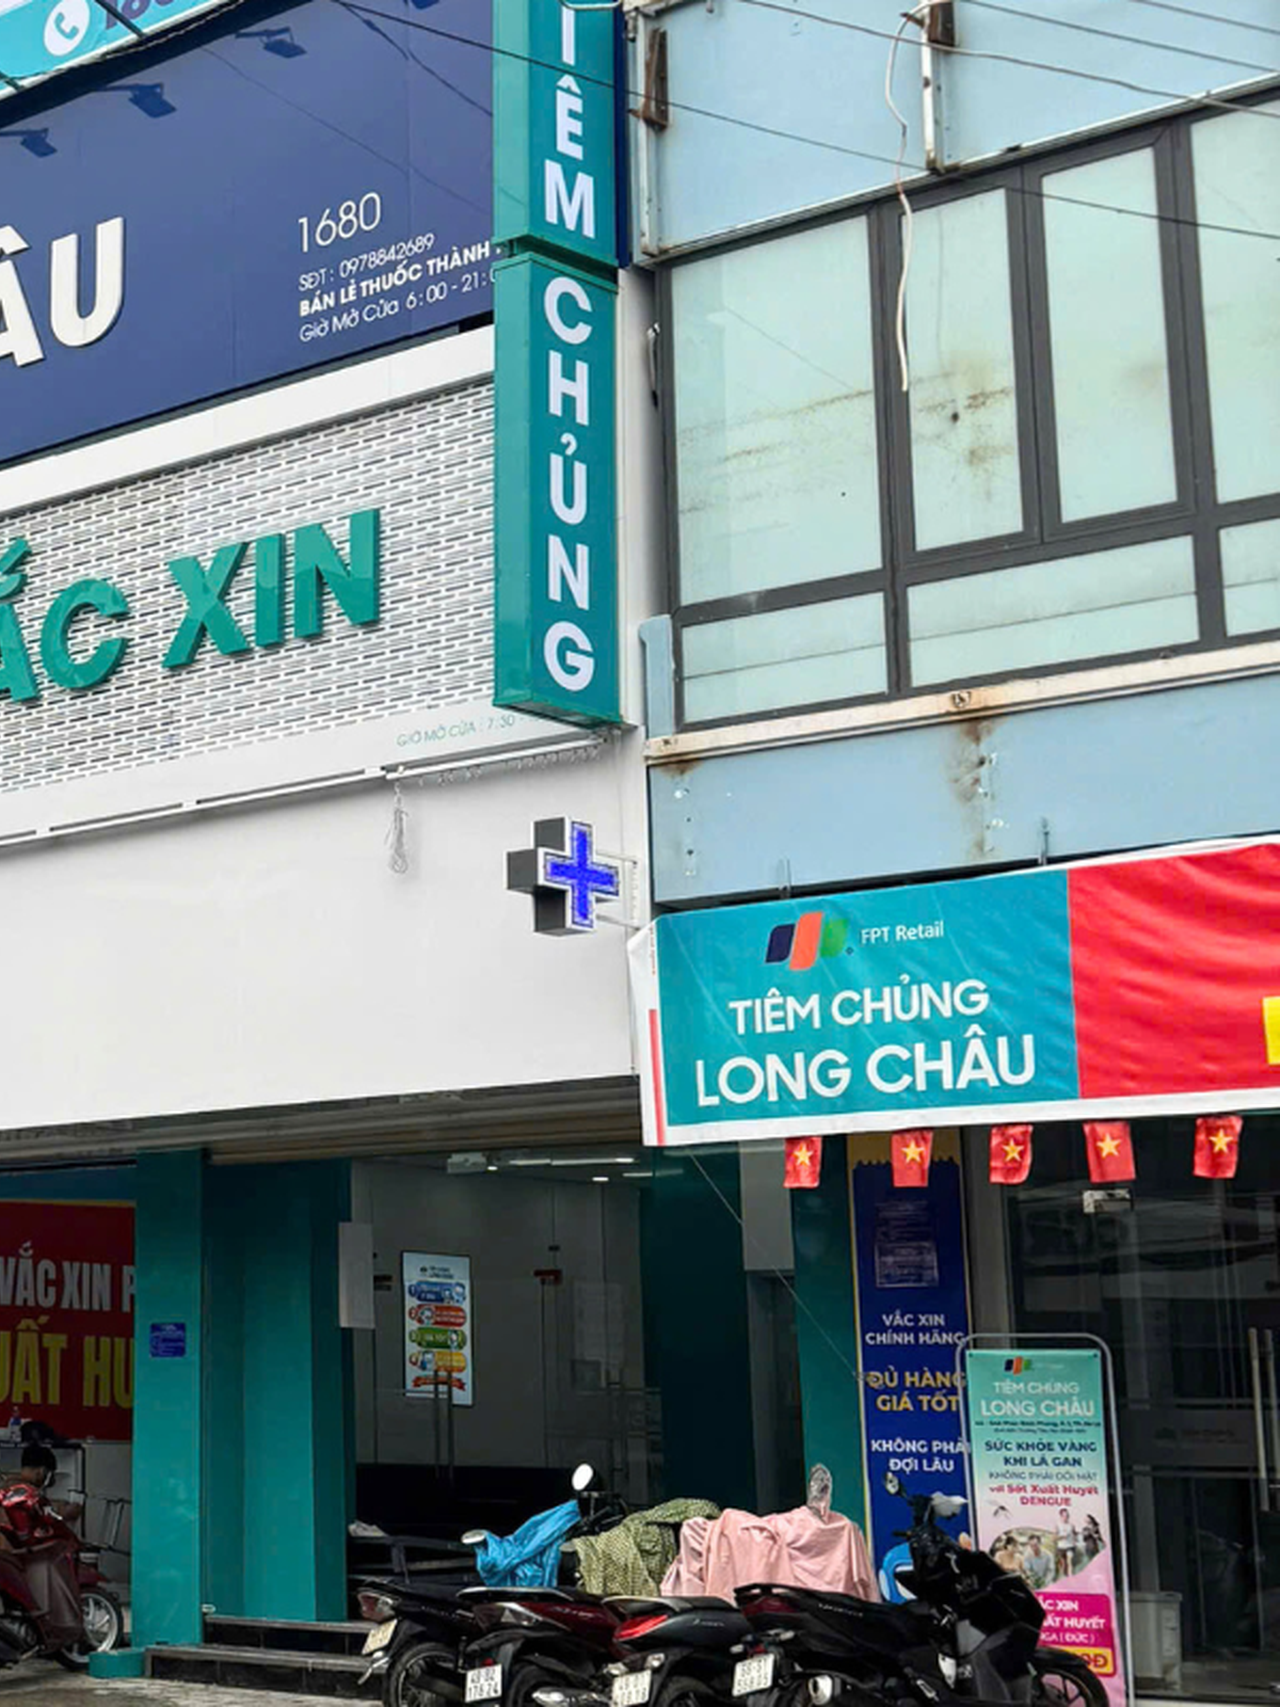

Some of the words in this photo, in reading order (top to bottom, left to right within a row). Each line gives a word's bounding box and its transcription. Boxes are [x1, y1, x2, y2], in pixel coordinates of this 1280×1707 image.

[298, 191, 382, 253] 1680
[338, 232, 435, 279] 0978842689
[299, 289, 336, 317] BÁN
[339, 280, 357, 305] LẺ
[359, 259, 424, 298] THUỐC
[426, 240, 491, 277] THÀNH
[299, 321, 330, 342] Giờ
[332, 308, 360, 333] Mở
[362, 299, 400, 323] Cửa
[542, 275, 597, 693] CHỦNG
[161, 508, 382, 669] XIN
[860, 926, 892, 946] FPT
[894, 919, 945, 944] Retail
[728, 987, 822, 1037] TIÊM
[830, 972, 990, 1027] CHỦNG
[694, 1047, 853, 1109] LONG
[864, 1023, 1036, 1096] CHÂU
[60, 1259, 113, 1312] XIN
[881, 1308, 915, 1328] VẮC
[916, 1313, 946, 1327] XIN
[865, 1329, 916, 1346] CHÍNH
[918, 1329, 967, 1346] HÃNG
[865, 1365, 899, 1389] ĐỦ
[904, 1367, 967, 1389] HÀNG
[993, 1378, 1025, 1395] TIÊM
[1026, 1379, 1080, 1395] CHỦNG
[876, 1390, 915, 1412] GIÁ
[917, 1390, 960, 1412] TỐT
[980, 1399, 1036, 1417] LONG
[1039, 1396, 1095, 1417] CHÂU
[870, 1437, 928, 1453] KHÔNG
[984, 1439, 1013, 1452] SỨC
[1057, 1439, 1098, 1452] VÀNG
[889, 1457, 920, 1475] ĐỢI
[922, 1457, 955, 1472] LÂU
[1003, 1456, 1028, 1467] KHI
[1051, 1456, 1083, 1468] GAN
[1030, 1482, 1061, 1495] Xuất
[1062, 1484, 1099, 1497] Huyết
[1019, 1496, 1072, 1507] DENGUE
[1055, 1600, 1079, 1612] XIN
[1063, 1615, 1107, 1630] HUYẾT
